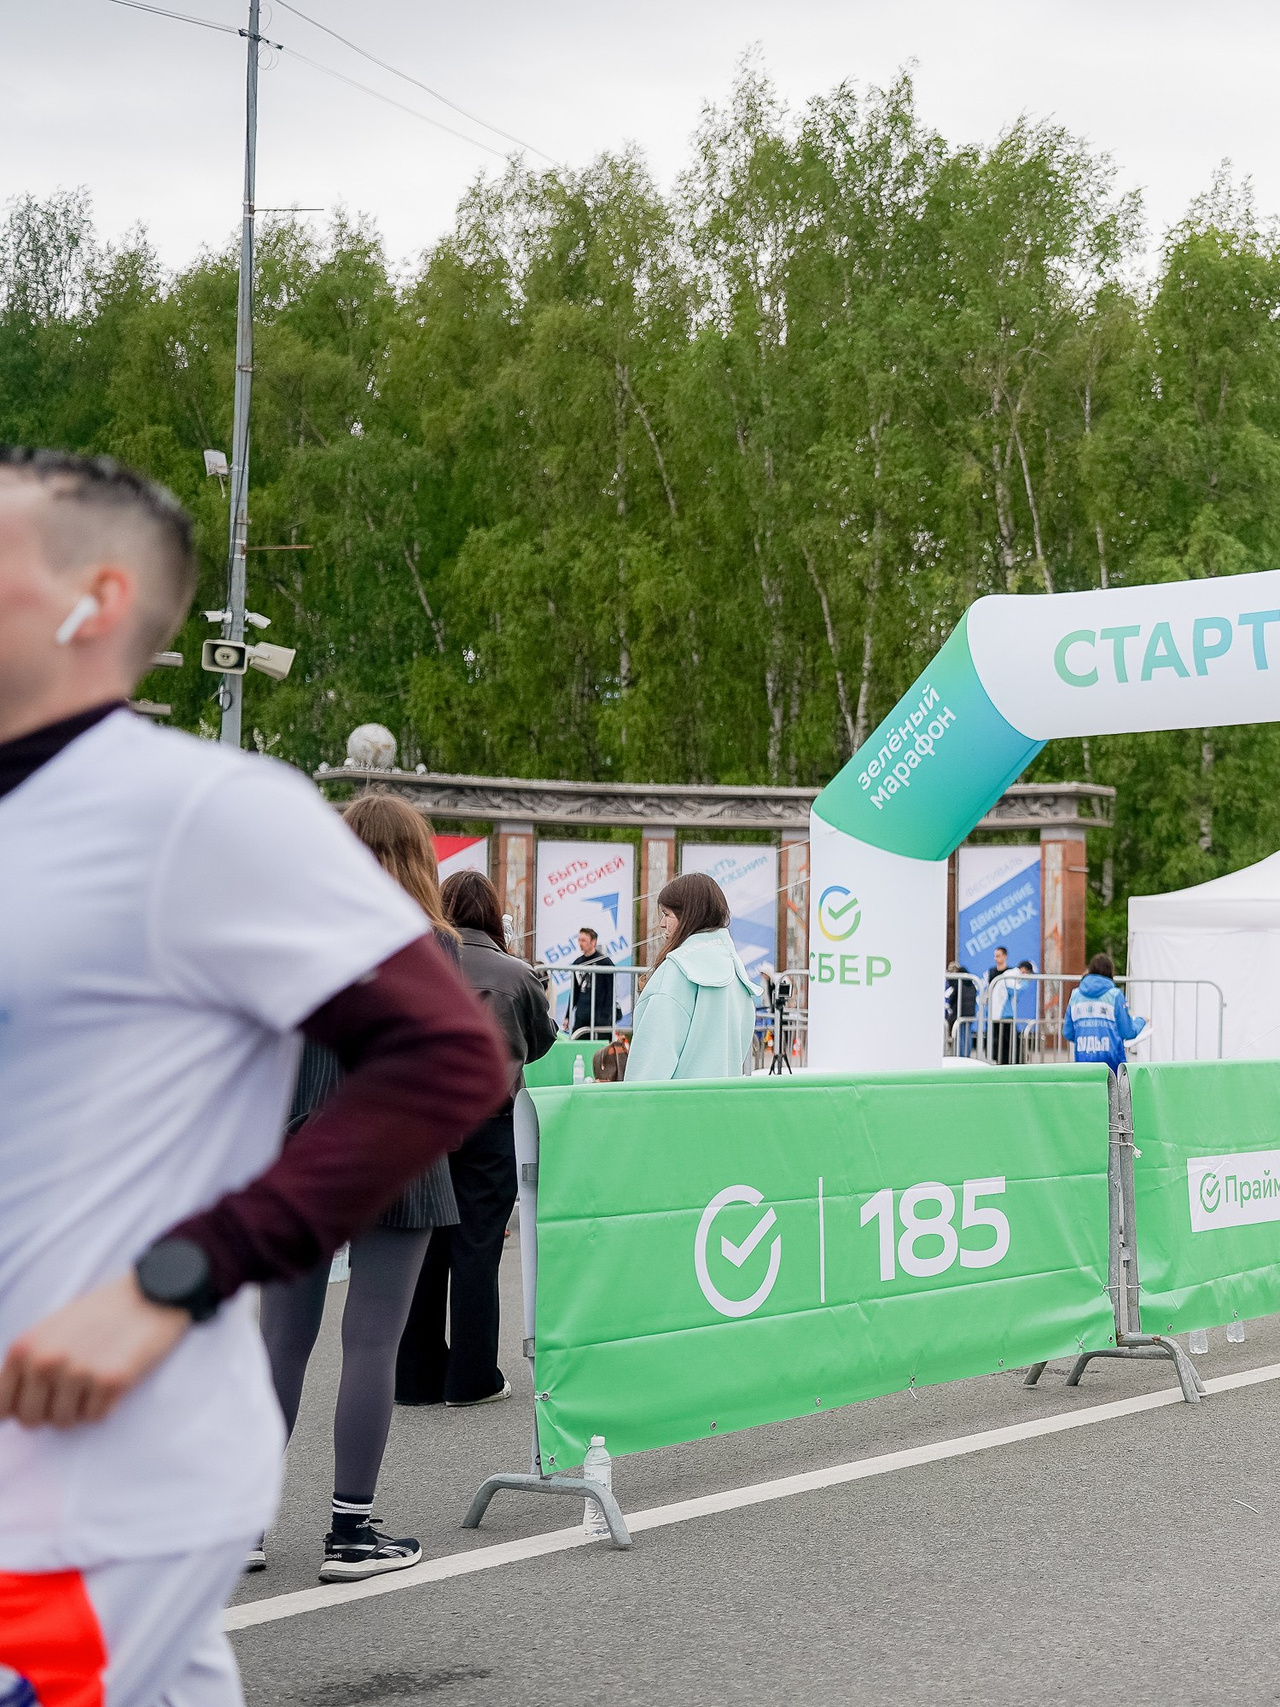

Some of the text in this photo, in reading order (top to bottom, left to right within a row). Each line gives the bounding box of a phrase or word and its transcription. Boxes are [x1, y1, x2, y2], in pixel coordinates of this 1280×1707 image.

[1054, 609, 1280, 688] СТАРТ
[857, 683, 940, 791] зелёный
[870, 706, 957, 810] марафон
[543, 856, 625, 907] С РОССИЕЙ
[547, 859, 588, 886] БЫТЬ
[706, 857, 737, 876] ЫТЬ
[718, 856, 768, 886] ИЖЕНИИ
[965, 900, 1038, 957] ПЕРВЫХ
[969, 881, 1035, 935] ДВИЖЕНИЕ
[545, 934, 578, 963] БЫ
[860, 1176, 1011, 1282] 185
